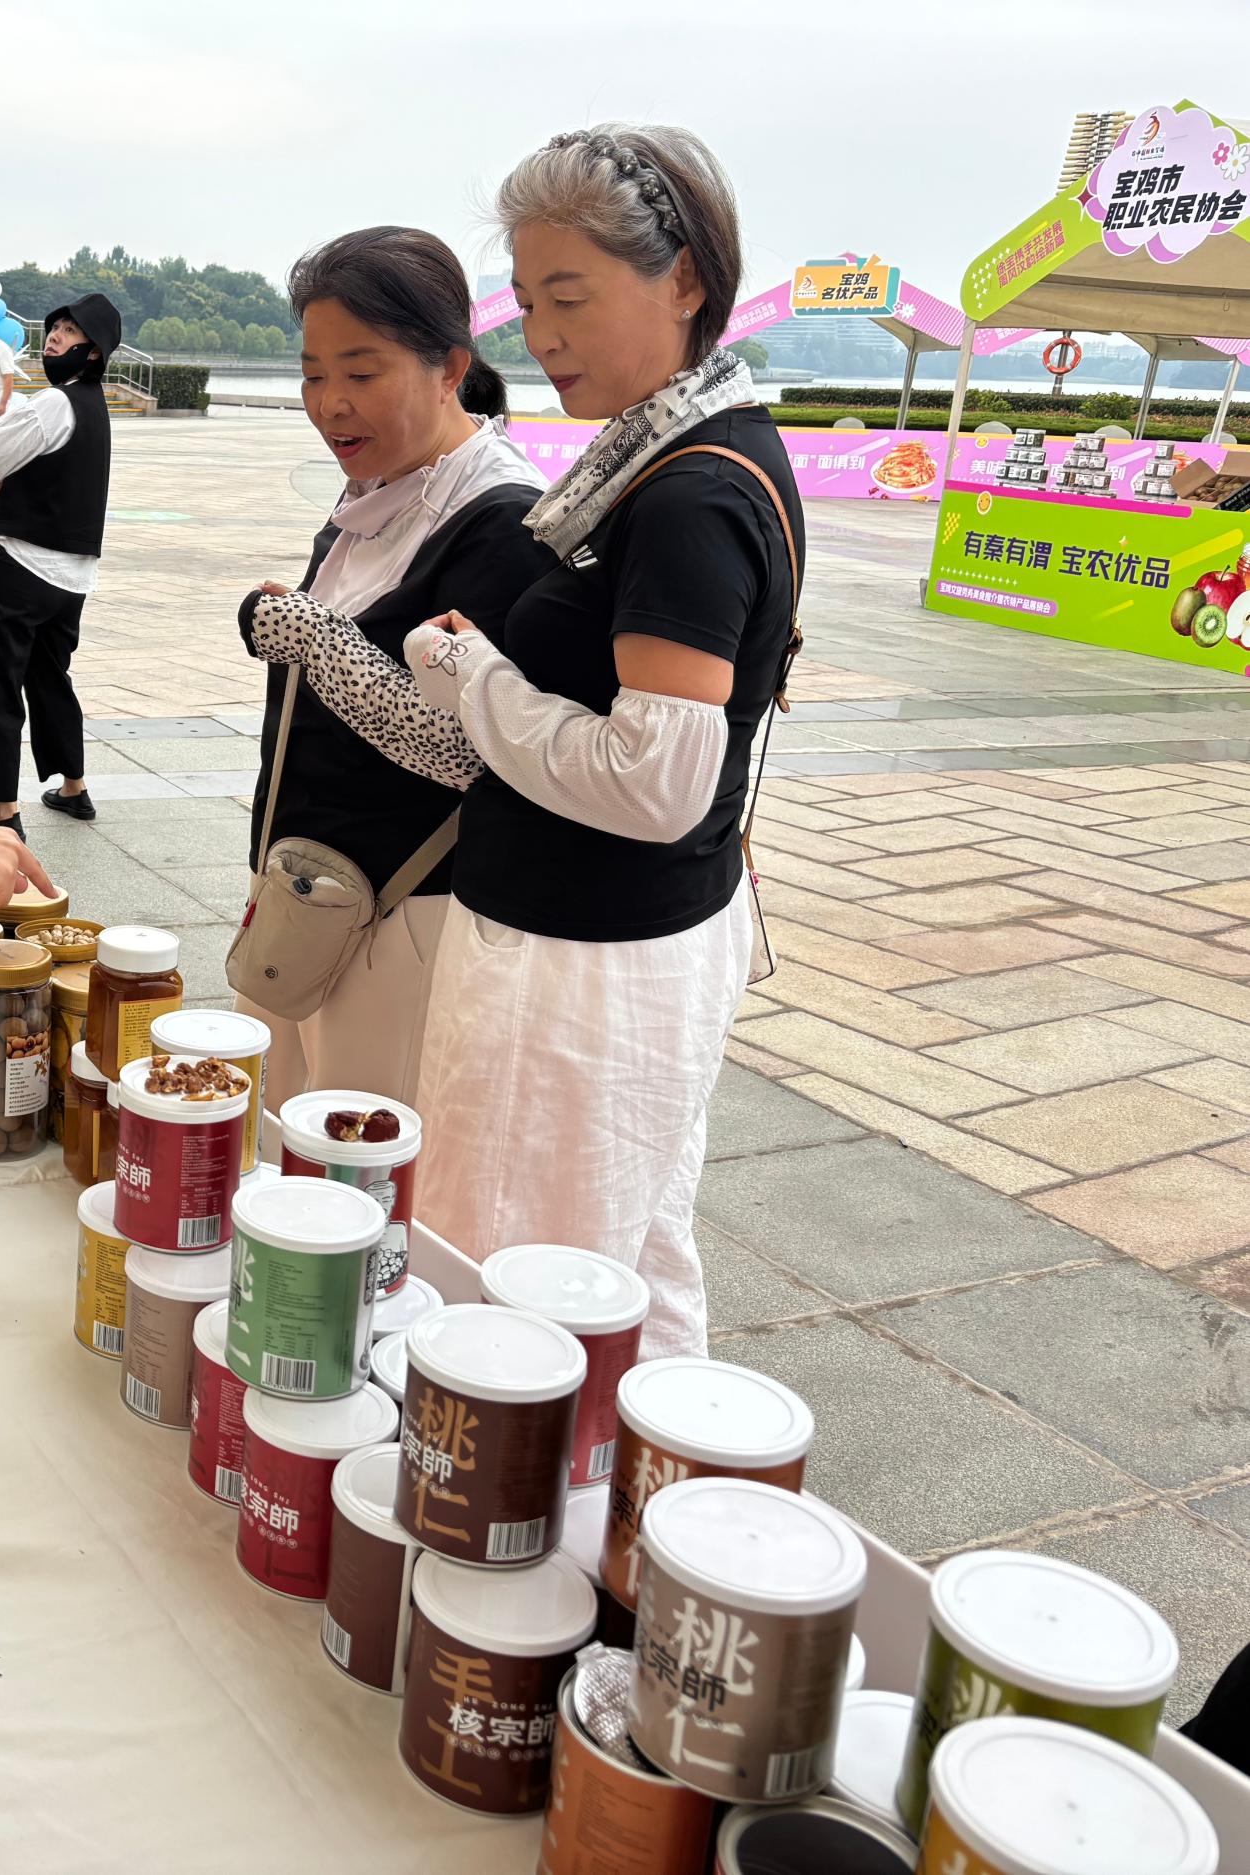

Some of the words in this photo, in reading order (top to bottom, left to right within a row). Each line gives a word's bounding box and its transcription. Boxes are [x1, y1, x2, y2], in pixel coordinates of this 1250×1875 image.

[1111, 164, 1185, 199] 宝鸡市
[1102, 189, 1247, 231] 职业农民协会
[821, 286, 879, 301] 名优产品
[839, 273, 871, 286] 宝鸡
[963, 530, 1053, 571] 有秦有渭
[1058, 545, 1171, 589] 宝农优品
[412, 1386, 480, 1543] 桃仁
[665, 1597, 760, 1773] 桃仁
[419, 1646, 495, 1795] 手工
[448, 1702, 557, 1747] 核宗師
